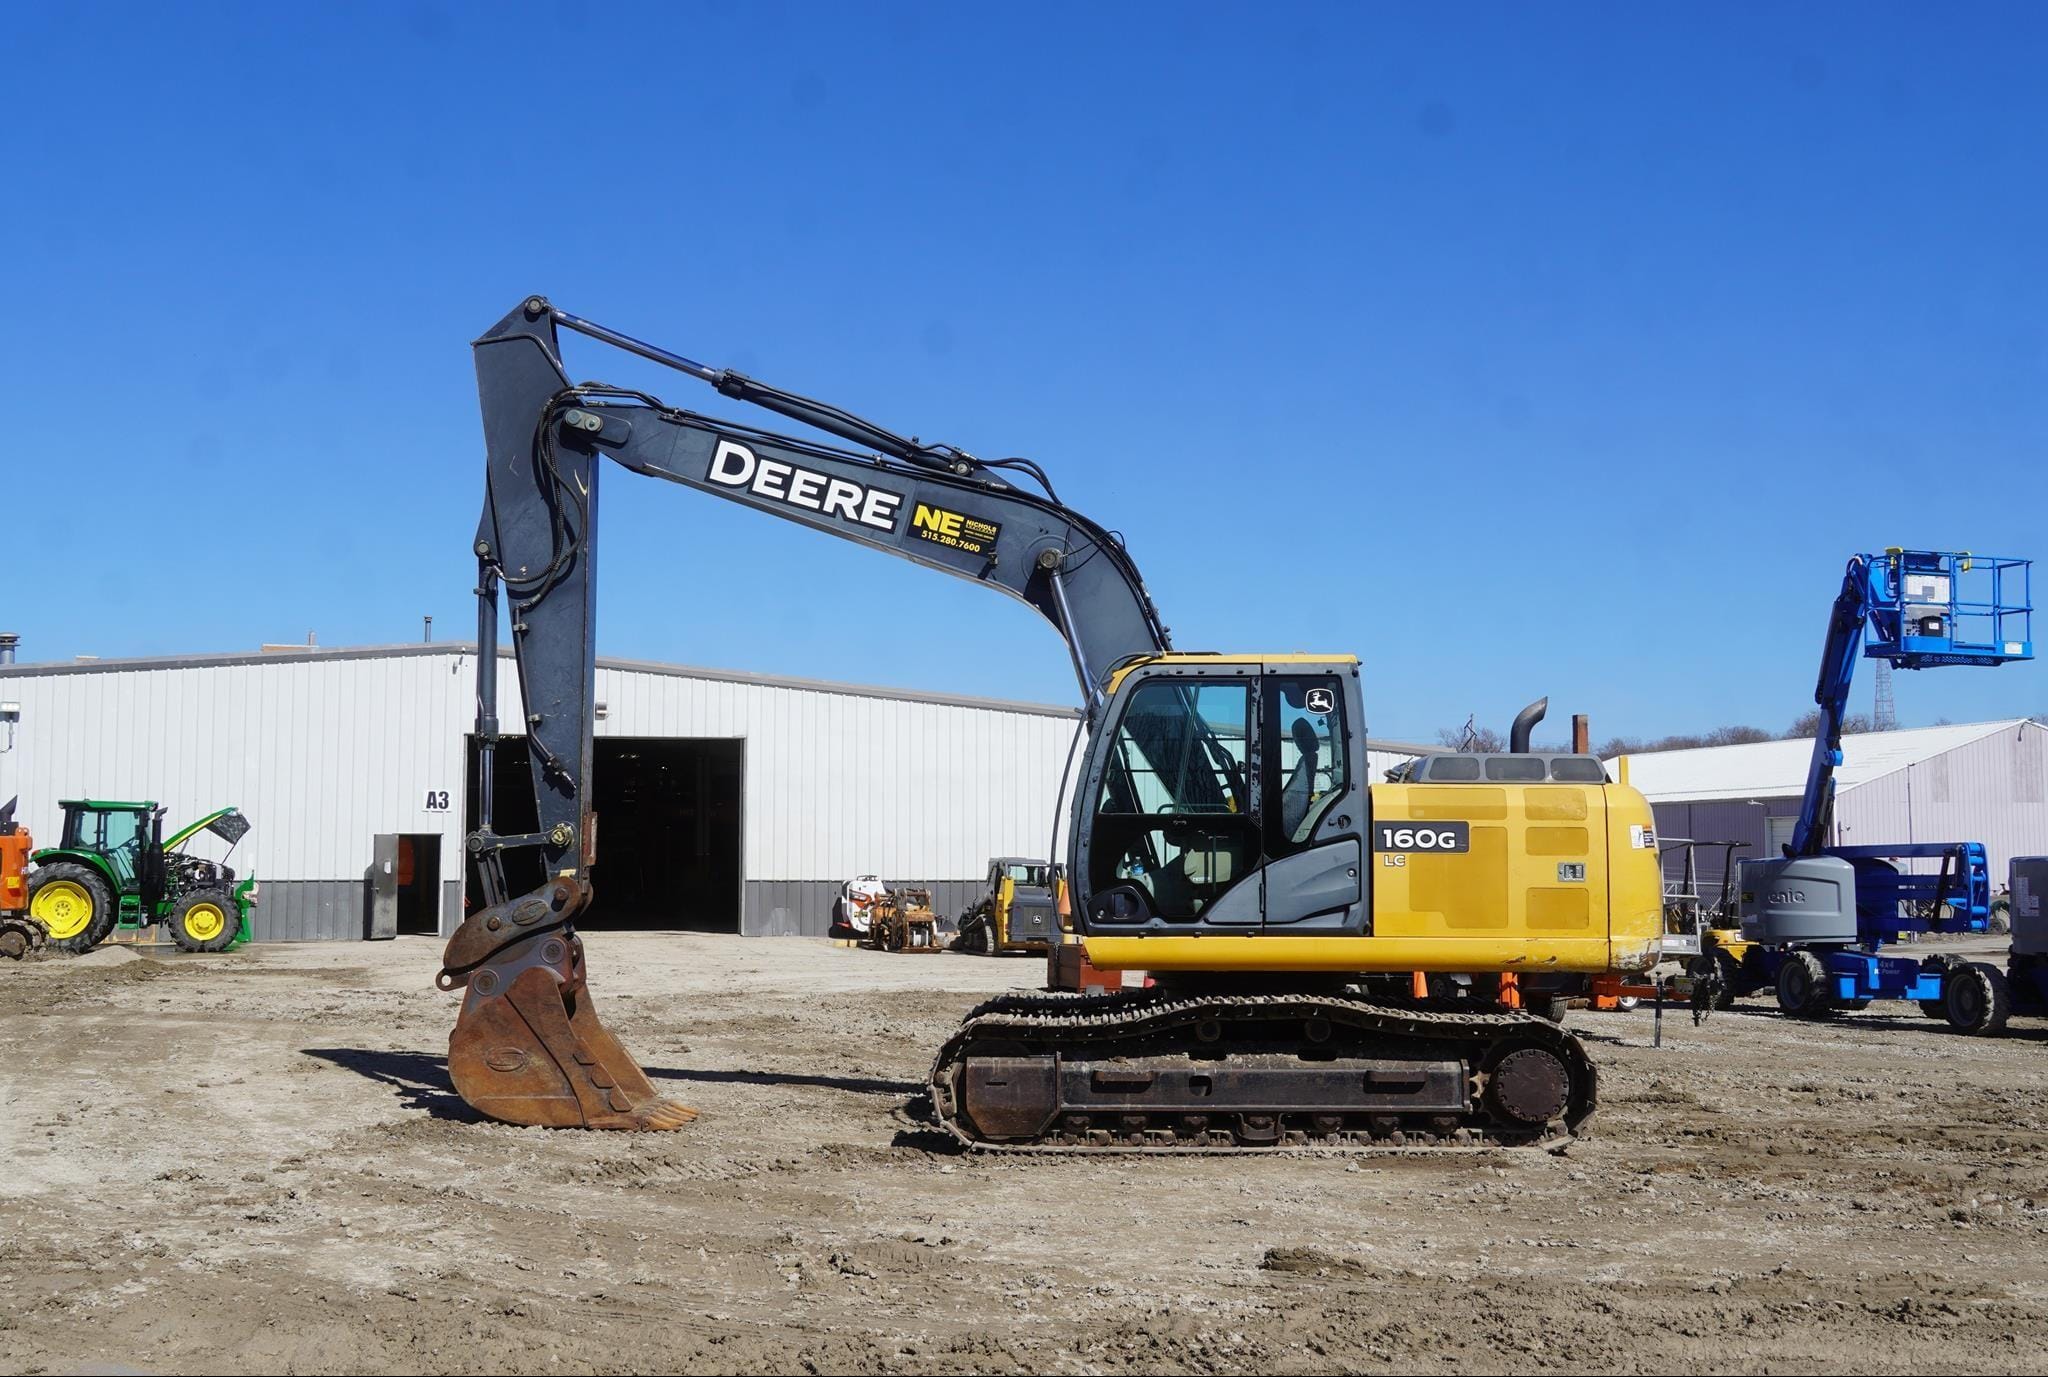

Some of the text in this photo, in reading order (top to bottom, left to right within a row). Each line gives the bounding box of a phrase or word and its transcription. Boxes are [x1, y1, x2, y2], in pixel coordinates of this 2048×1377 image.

[708, 439, 900, 531] DEERE
[913, 504, 965, 537] NE
[965, 519, 997, 532] NICHOLS
[921, 529, 980, 553] 515.280.7600
[426, 791, 449, 809] A3
[1383, 829, 1456, 849] 160G
[1384, 855, 1405, 867] LC
